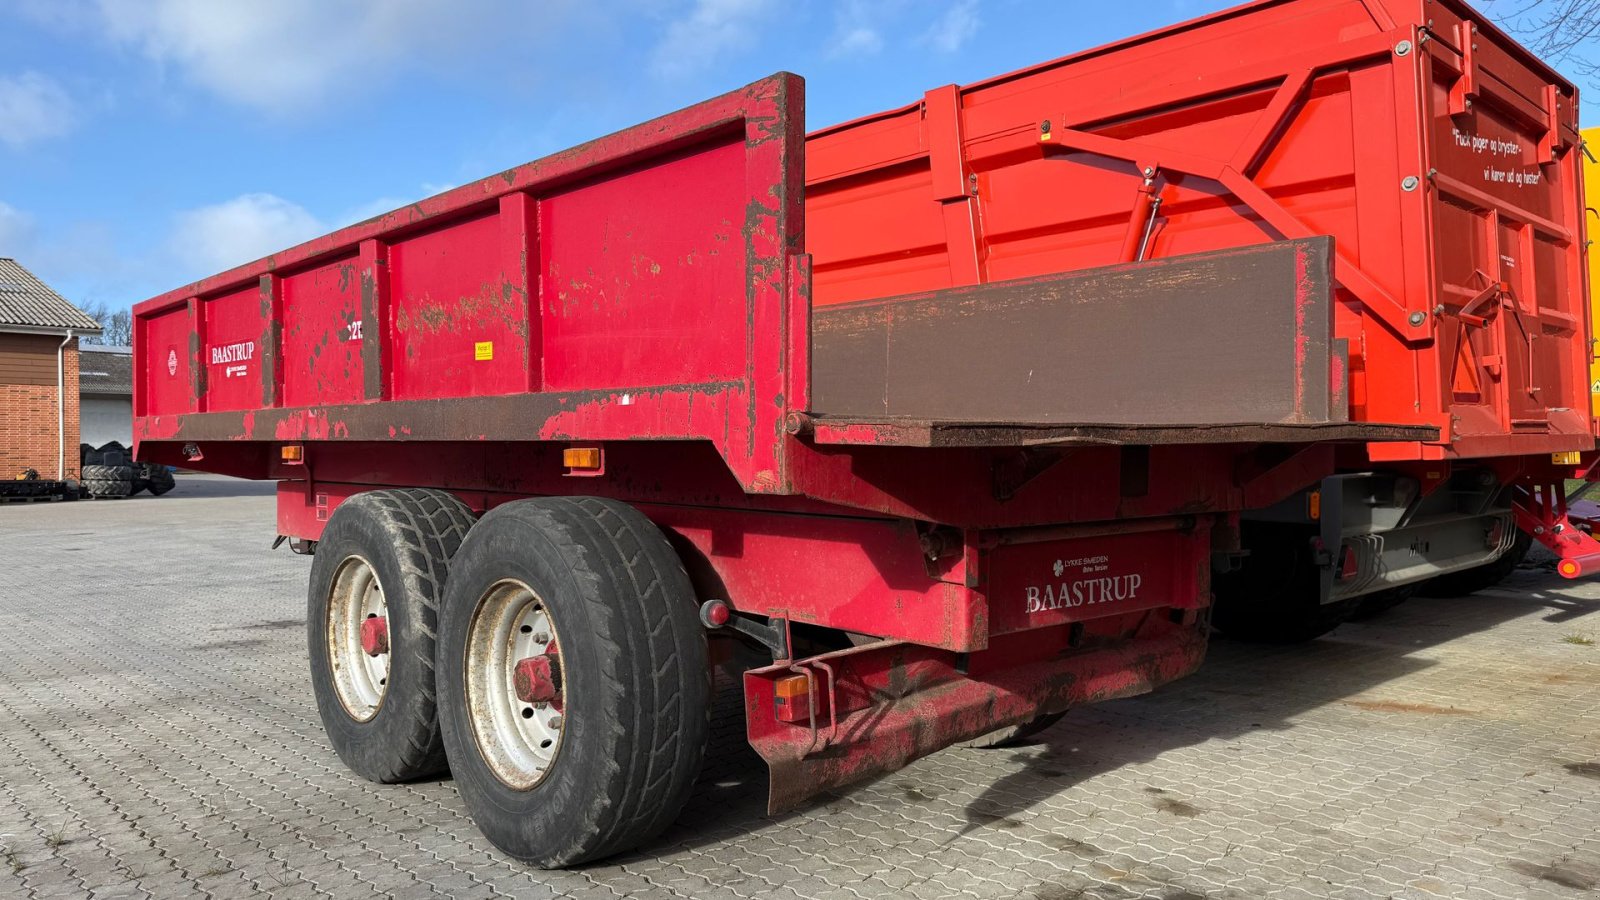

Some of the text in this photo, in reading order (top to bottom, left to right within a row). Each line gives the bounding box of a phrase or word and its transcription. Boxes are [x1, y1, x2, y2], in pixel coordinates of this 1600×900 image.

[1472, 133, 1489, 153] piger
[1490, 140, 1497, 155] og
[1483, 165, 1490, 181] vi
[1507, 167, 1515, 183] ud
[1515, 171, 1523, 187] og
[212, 341, 254, 364] BAASTRUP
[1065, 555, 1109, 567] LYKKE SMEDEN
[1025, 573, 1142, 614] BAASTRUP
